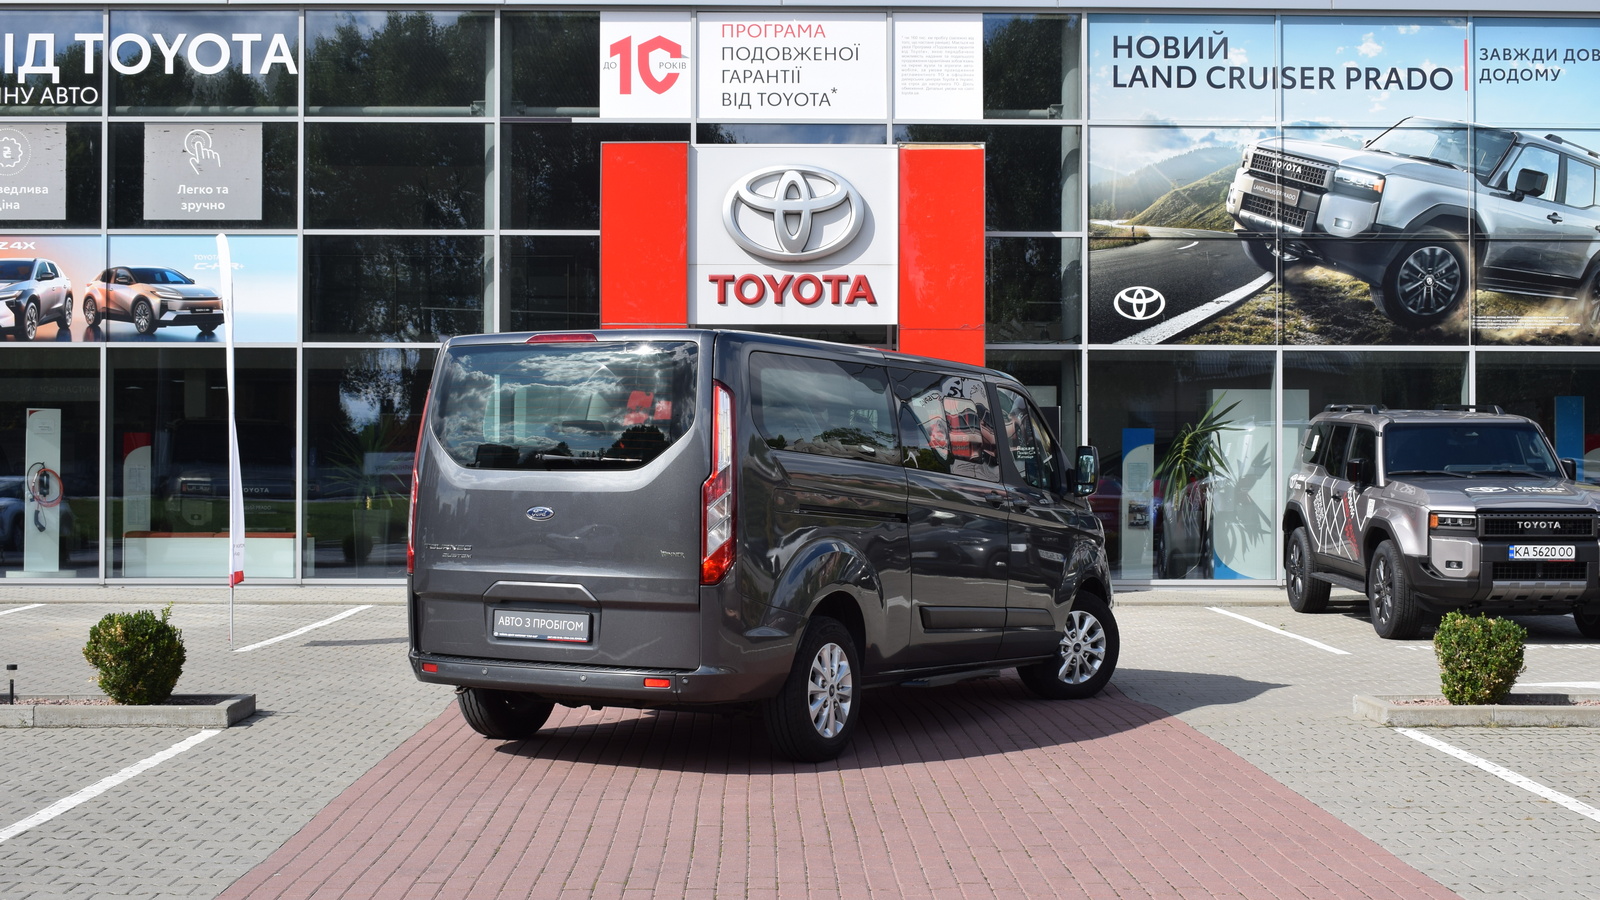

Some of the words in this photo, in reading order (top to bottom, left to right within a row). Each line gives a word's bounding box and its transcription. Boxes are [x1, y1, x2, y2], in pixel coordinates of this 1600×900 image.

[721, 24, 826, 39] ПРОГРАМА
[74, 32, 298, 75] TOYOTA
[721, 43, 861, 63] ПОДОВЖЕНОЇ
[1113, 31, 1229, 60] НОВИЙ
[1479, 48, 1557, 64] ЗАВЖДИ
[603, 62, 617, 70] ДО
[659, 61, 687, 70] РОКІВ
[721, 66, 802, 84] ГАРАНТІЇ
[1113, 66, 1198, 89] LAND
[1206, 67, 1336, 90] CRUISER
[1347, 68, 1453, 91] PRADO
[1479, 68, 1561, 84] ДОДОМУ
[40, 87, 99, 104] АВТО
[721, 92, 752, 110] ВІД
[1272, 160, 1302, 173] TOYOTA
[177, 185, 213, 195] Легко
[216, 187, 229, 195] та
[0, 200, 20, 211] іна
[180, 201, 226, 211] зручно
[708, 273, 878, 306] TOYOTA
[1517, 521, 1561, 529] TOYOTA
[1514, 547, 1530, 557] KA
[1532, 547, 1556, 557] 5620
[498, 616, 523, 627] АВТО
[533, 618, 584, 631] ПРОБІГОМ
